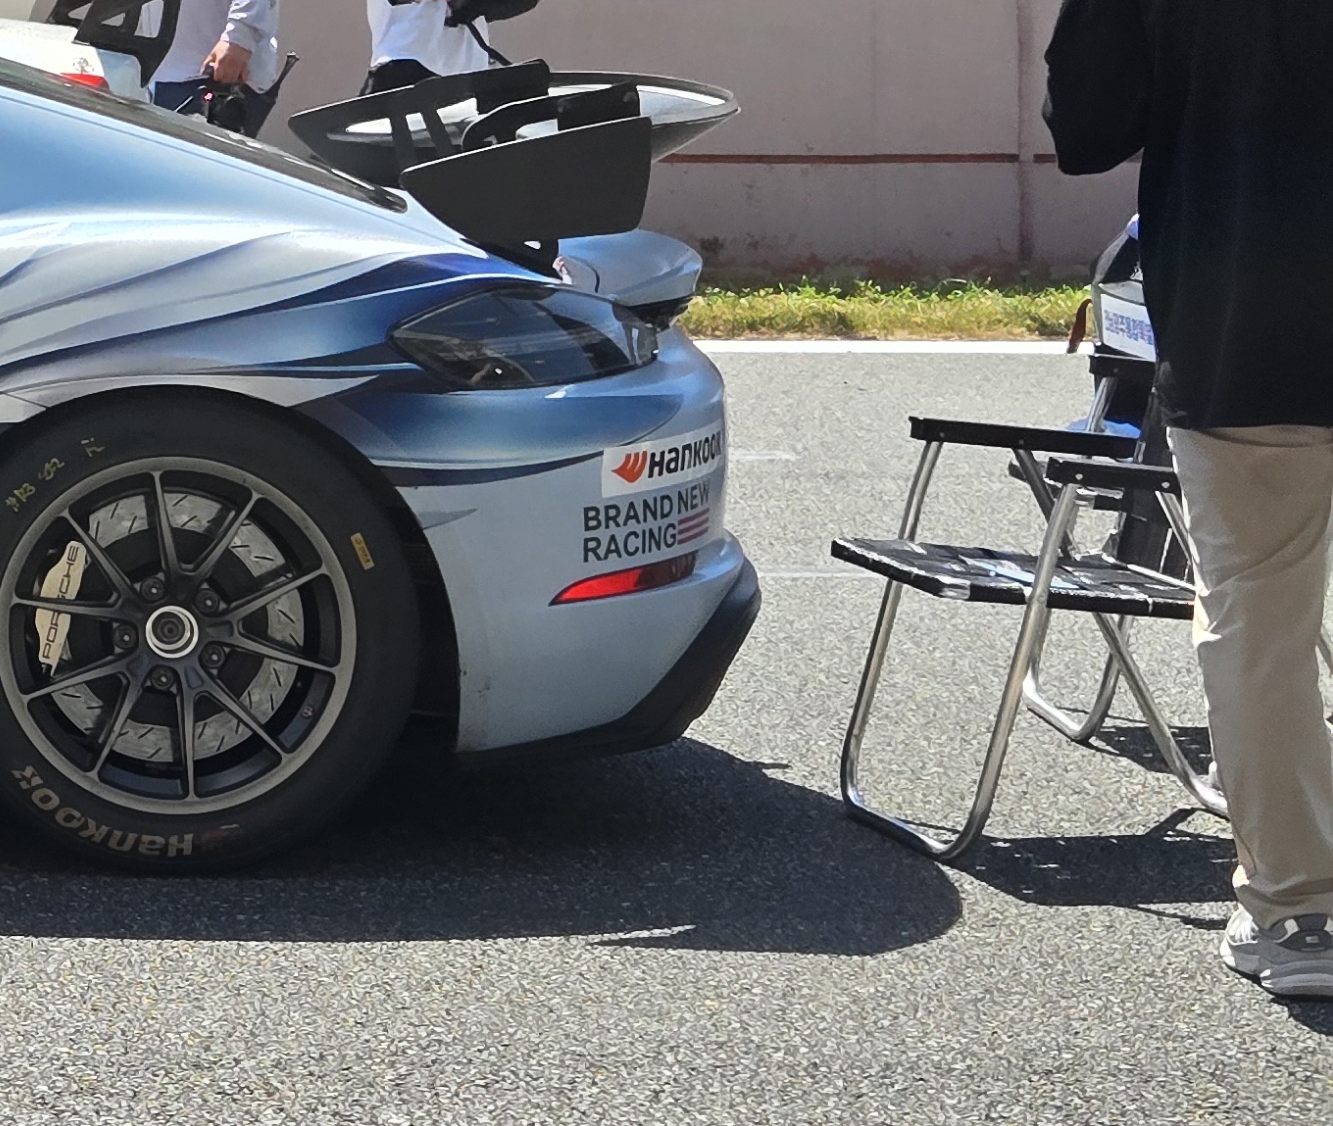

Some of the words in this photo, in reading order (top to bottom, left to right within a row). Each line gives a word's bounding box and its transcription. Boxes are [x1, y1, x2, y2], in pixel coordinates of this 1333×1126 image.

[583, 494, 674, 532] BRAND
[677, 478, 711, 515] NEW
[583, 523, 677, 563] RACING
[42, 545, 79, 660] PORCHE
